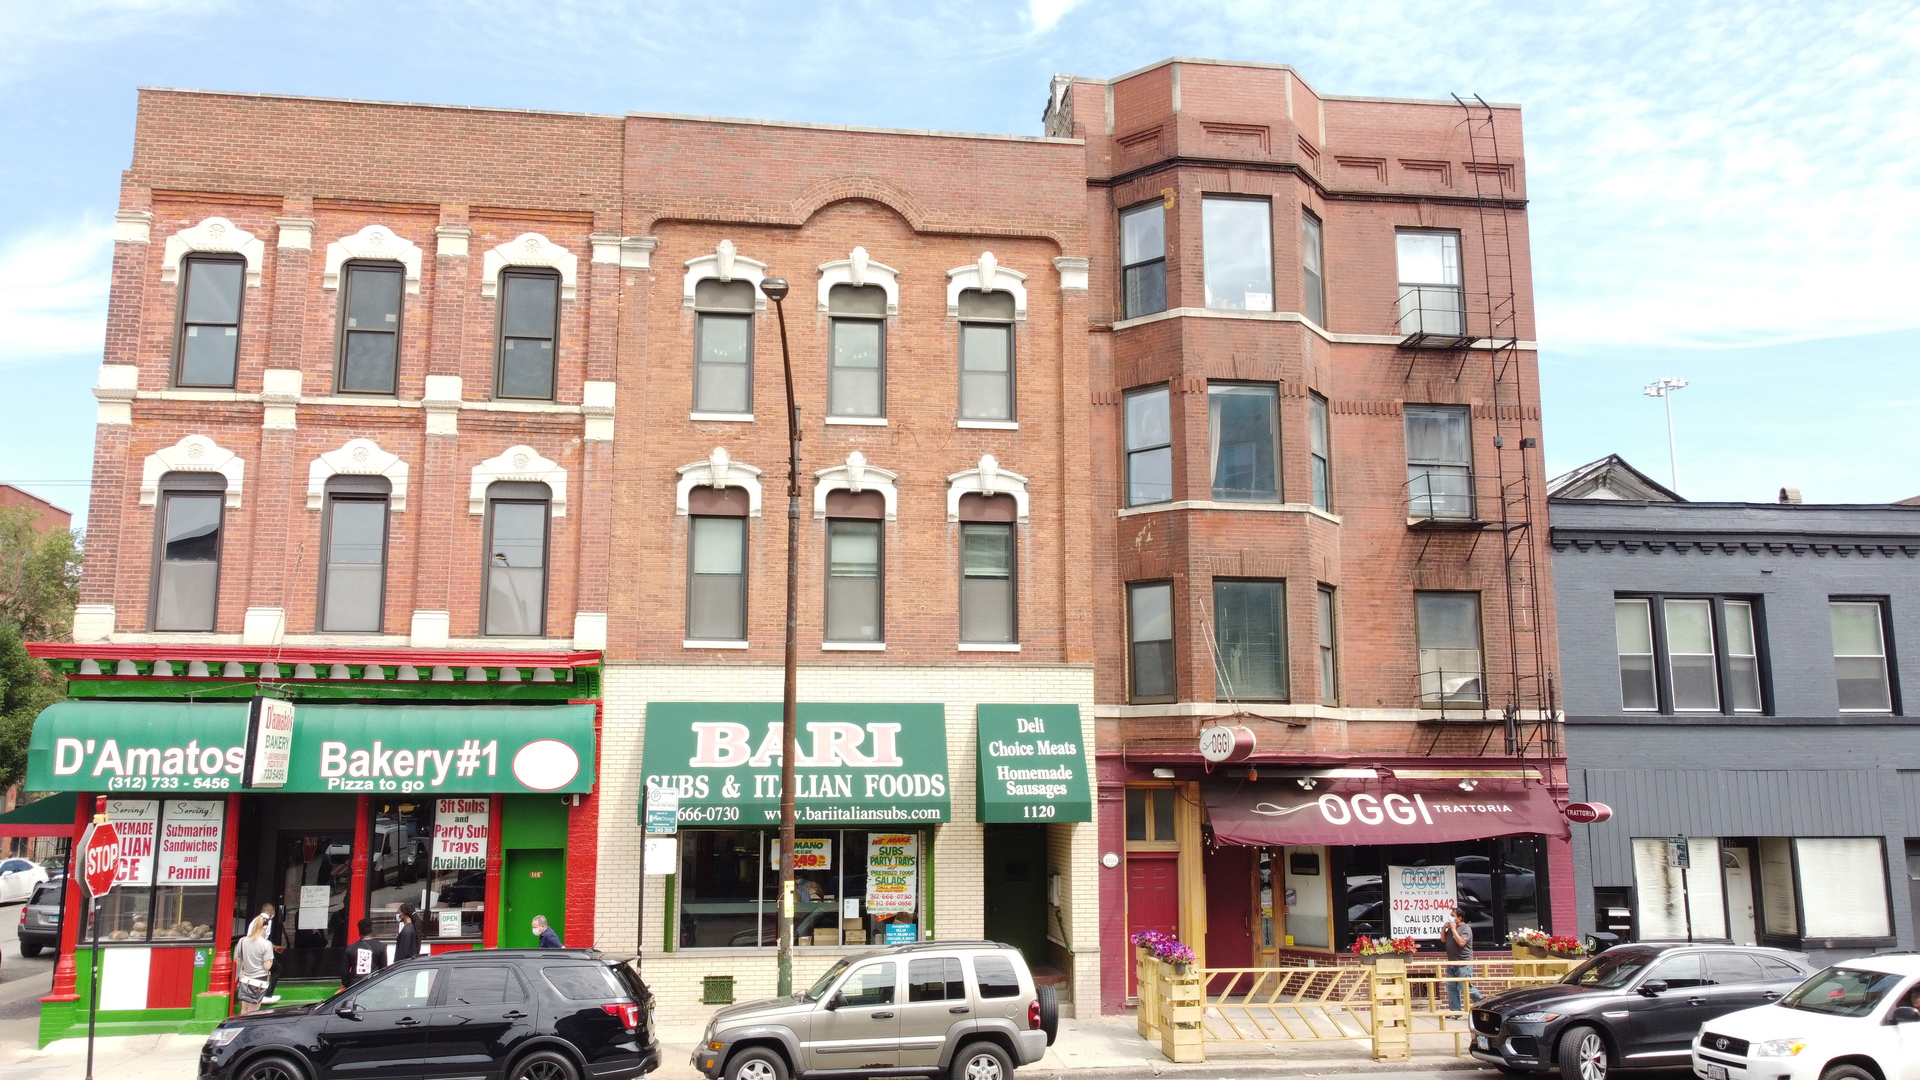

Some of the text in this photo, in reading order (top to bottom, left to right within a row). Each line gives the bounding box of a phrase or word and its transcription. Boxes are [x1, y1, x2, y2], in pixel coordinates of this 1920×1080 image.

[1017, 717, 1045, 733] Deli
[265, 735, 289, 750] BAKERY
[689, 721, 903, 768] BARI
[989, 740, 1077, 757] Choice Meats
[1212, 733, 1229, 753] OGGI
[54, 737, 245, 777] D'Amatos
[997, 764, 1073, 780] Homemade
[108, 777, 146, 791] (312)
[152, 777, 179, 789] 733
[193, 778, 229, 789] 5456
[328, 778, 424, 793] Pizza to go
[646, 773, 945, 798] SUBS & ITLIAN FOODS
[1006, 781, 1067, 799] Sausages
[108, 802, 151, 816] Serving!
[173, 802, 215, 817] Serving!
[440, 799, 485, 813] 3ft Subs
[677, 806, 740, 821] 666-0730
[1023, 805, 1055, 818] 1120
[1318, 793, 1512, 825] OGGI TRATTORIA
[455, 815, 469, 823] and
[115, 822, 154, 835] MEMADE
[166, 824, 218, 838] Submarine
[434, 825, 488, 840] Party Sub
[121, 837, 152, 857] LIAN
[164, 839, 218, 852] Sandwiches
[441, 840, 479, 855] Trays
[794, 842, 824, 850] MANO
[887, 836, 912, 844] MAKE
[879, 846, 904, 856] SUBS
[87, 843, 119, 875] STOP
[433, 856, 486, 870] Available
[870, 856, 915, 866] PARTY TRAYS
[115, 858, 140, 881] CE
[168, 866, 211, 880] Panini
[875, 876, 906, 885] SALADS
[1401, 868, 1445, 889] OGGI
[1393, 899, 1454, 911] 312-733-0442
[1404, 915, 1444, 923] CALL US FOR
